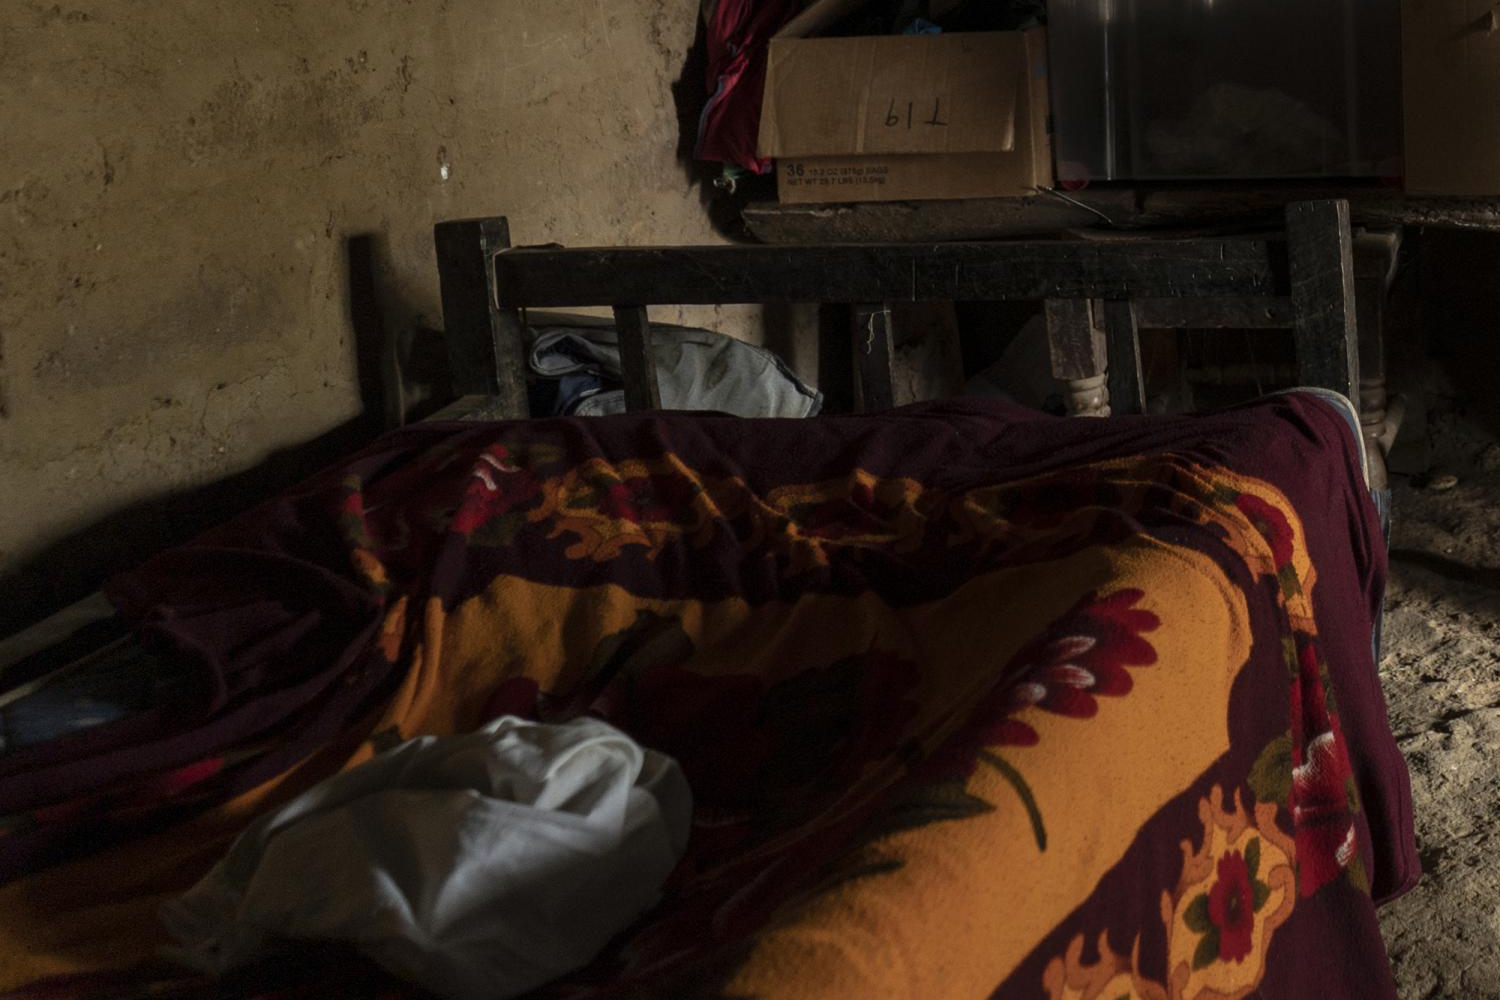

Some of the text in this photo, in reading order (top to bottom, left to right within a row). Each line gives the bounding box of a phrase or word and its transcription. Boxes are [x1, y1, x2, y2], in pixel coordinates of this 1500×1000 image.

[787, 164, 804, 176] 36
[827, 168, 838, 176] OZ
[865, 166, 888, 175] BAGS
[787, 177, 803, 185] NET
[805, 177, 817, 185] WT
[838, 177, 853, 185] LBS
